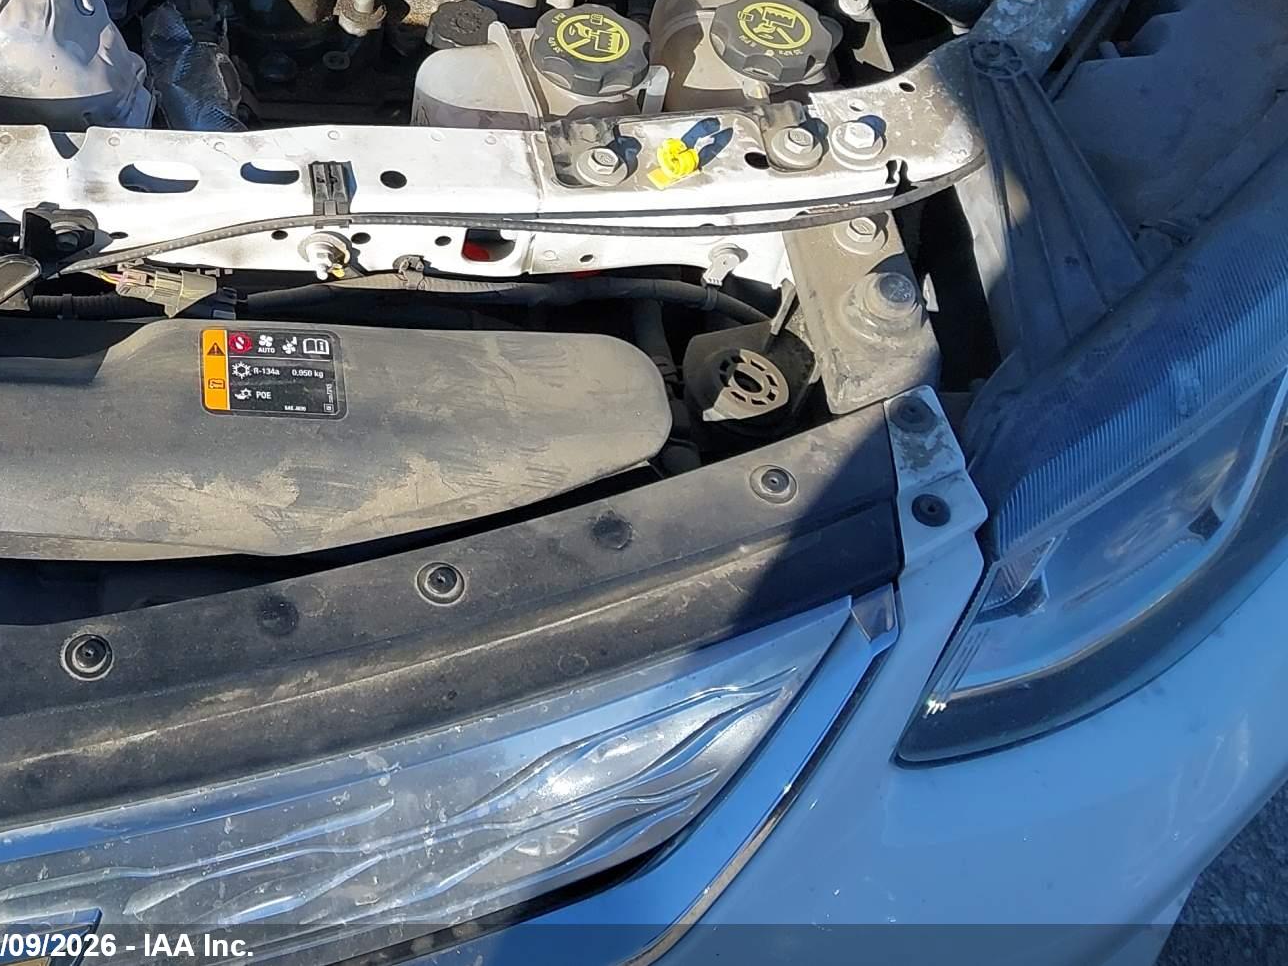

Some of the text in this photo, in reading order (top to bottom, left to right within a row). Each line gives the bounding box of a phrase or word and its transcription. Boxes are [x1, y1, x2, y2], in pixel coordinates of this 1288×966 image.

[253, 367, 281, 376] R-134a
[314, 370, 324, 379] kg
[256, 390, 272, 400] POE
